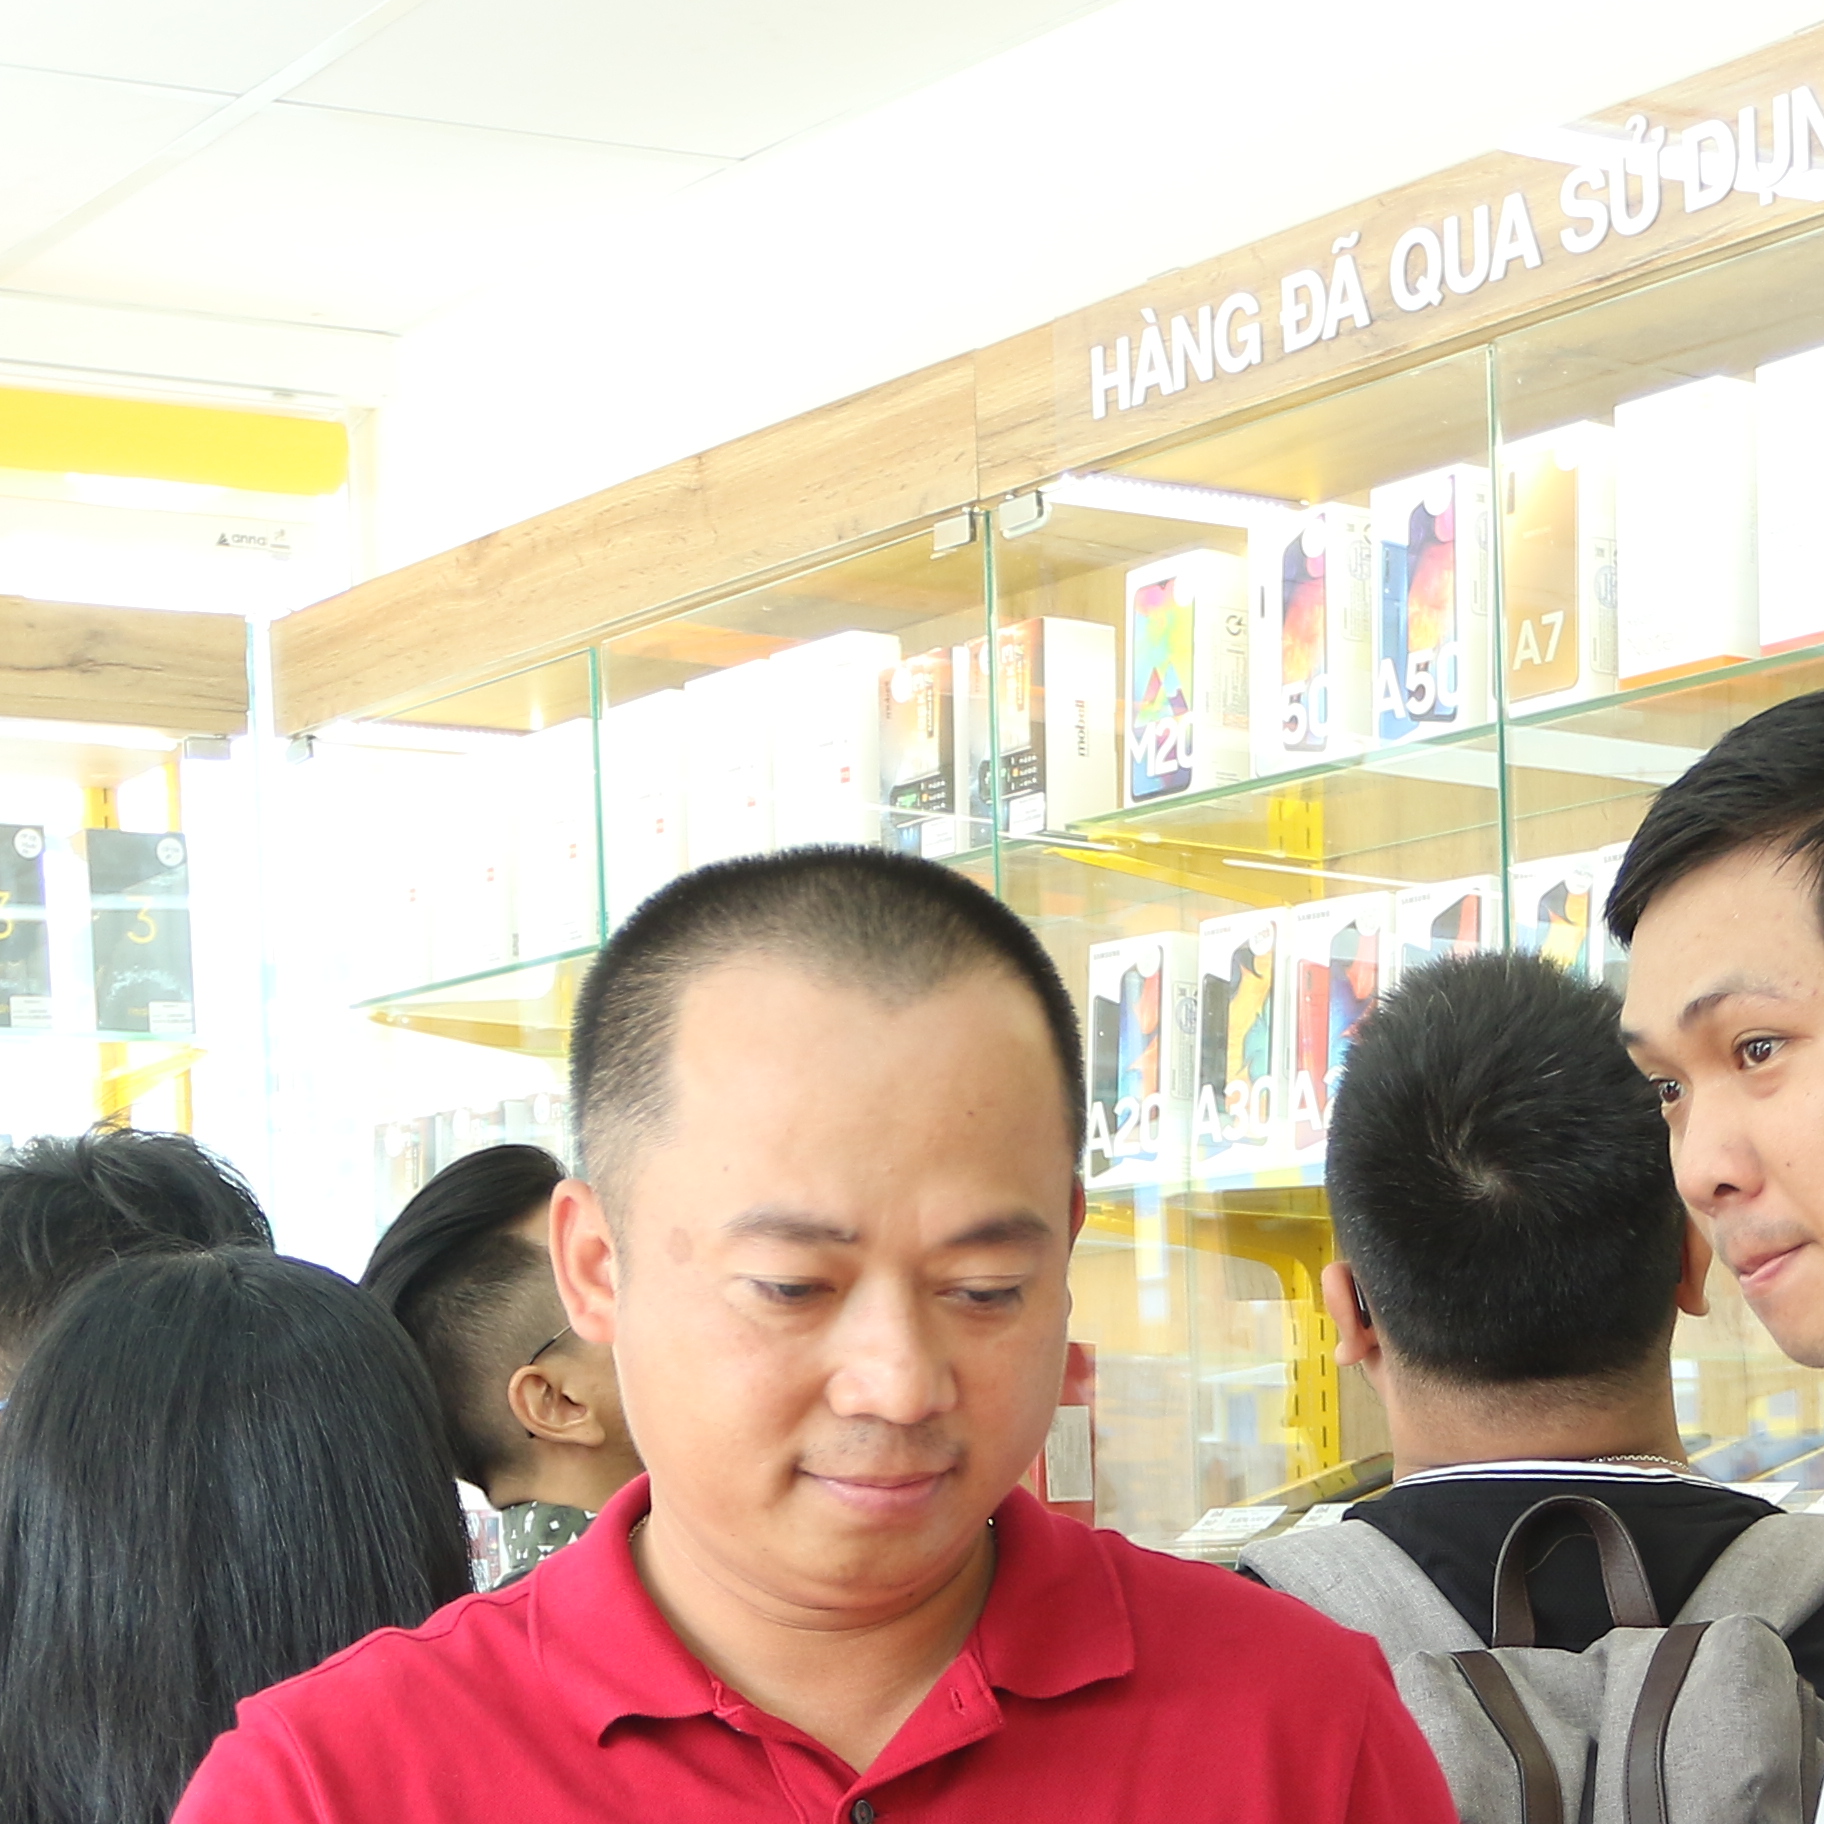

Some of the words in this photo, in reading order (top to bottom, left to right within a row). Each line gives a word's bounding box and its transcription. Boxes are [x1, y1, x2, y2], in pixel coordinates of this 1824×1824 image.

[1088, 293, 1263, 420] HÀNG
[1280, 231, 1372, 354] ĐÃ
[1389, 193, 1542, 313] QUA
[1559, 113, 1669, 255] SỬ
[1513, 610, 1564, 671] A7
[1378, 641, 1466, 719] A50
[1129, 710, 1199, 778] M20
[127, 896, 158, 944] 3
[1297, 911, 1330, 922] SAMSUNG
[1087, 1092, 1166, 1158] A20
[1193, 1075, 1276, 1146] A30
